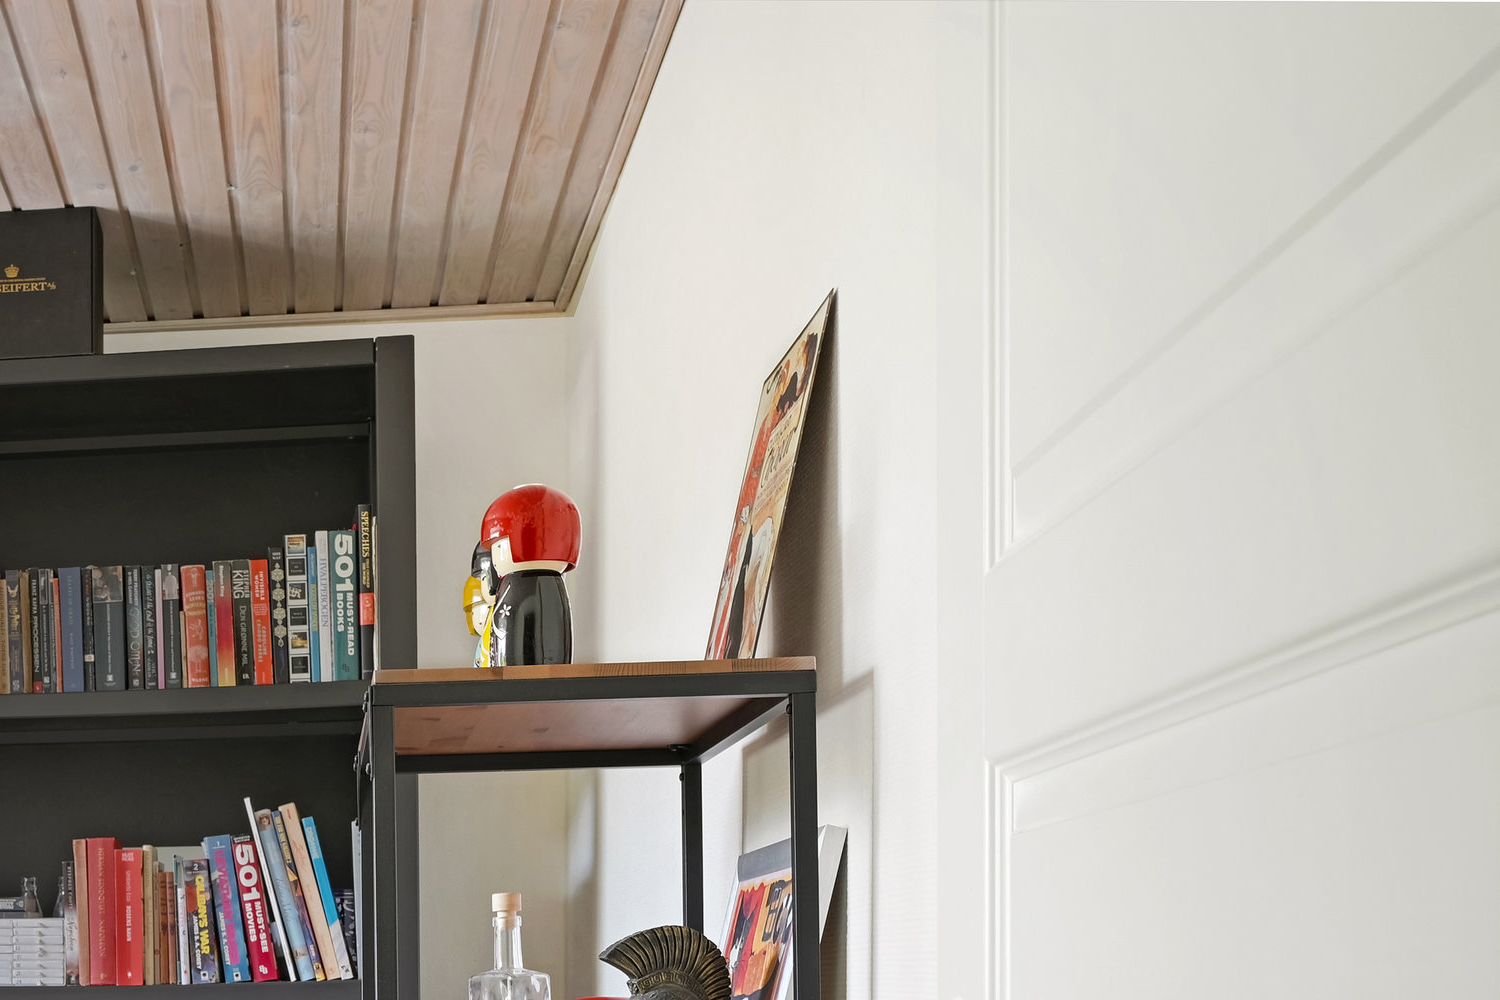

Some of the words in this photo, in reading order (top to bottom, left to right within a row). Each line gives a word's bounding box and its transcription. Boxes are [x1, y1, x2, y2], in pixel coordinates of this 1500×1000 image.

[361, 511, 370, 557] SPEECHES
[233, 570, 244, 599] KING
[334, 533, 354, 592] 501
[319, 558, 329, 627] HVALPEBOGEN
[336, 593, 344, 632] BOOKS
[240, 623, 248, 652] GRØNNE
[346, 592, 355, 656] MUST-READ
[215, 850, 234, 920] LEVIATHAN
[235, 844, 260, 901] 501
[196, 875, 208, 927] CALIBAN'S
[244, 902, 257, 942] MOVIES
[254, 901, 268, 953] MUST-SEE
[201, 929, 210, 954] WAR
